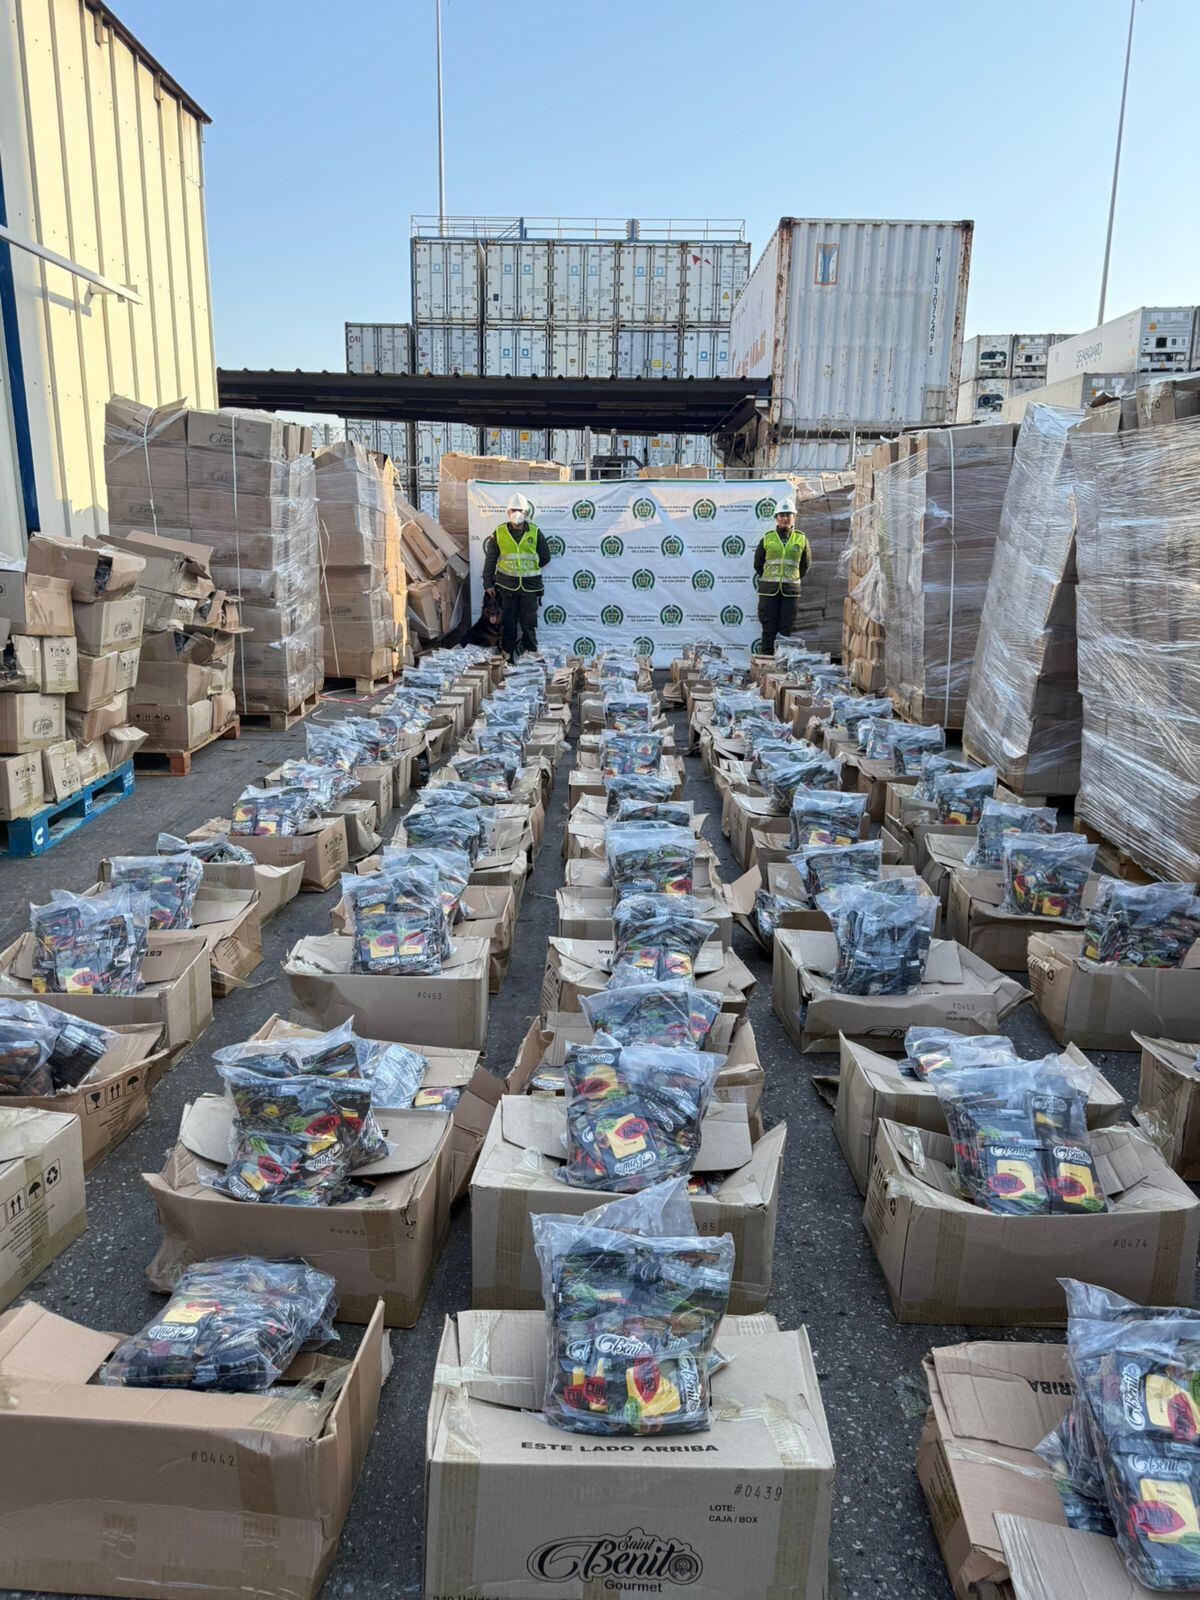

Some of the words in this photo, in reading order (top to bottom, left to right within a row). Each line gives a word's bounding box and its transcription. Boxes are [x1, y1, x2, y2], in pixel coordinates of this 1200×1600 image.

[1028, 1380, 1072, 1396] RIBA
[521, 1442, 573, 1451] ESTE
[642, 1444, 720, 1452] ARRIBA
[190, 1450, 236, 1468] #0442
[733, 1483, 782, 1501] #0439
[709, 1504, 736, 1512] LOTE:
[618, 1537, 656, 1551] Saint
[536, 1538, 700, 1582] Benito
[604, 1579, 662, 1592] Gourmet
